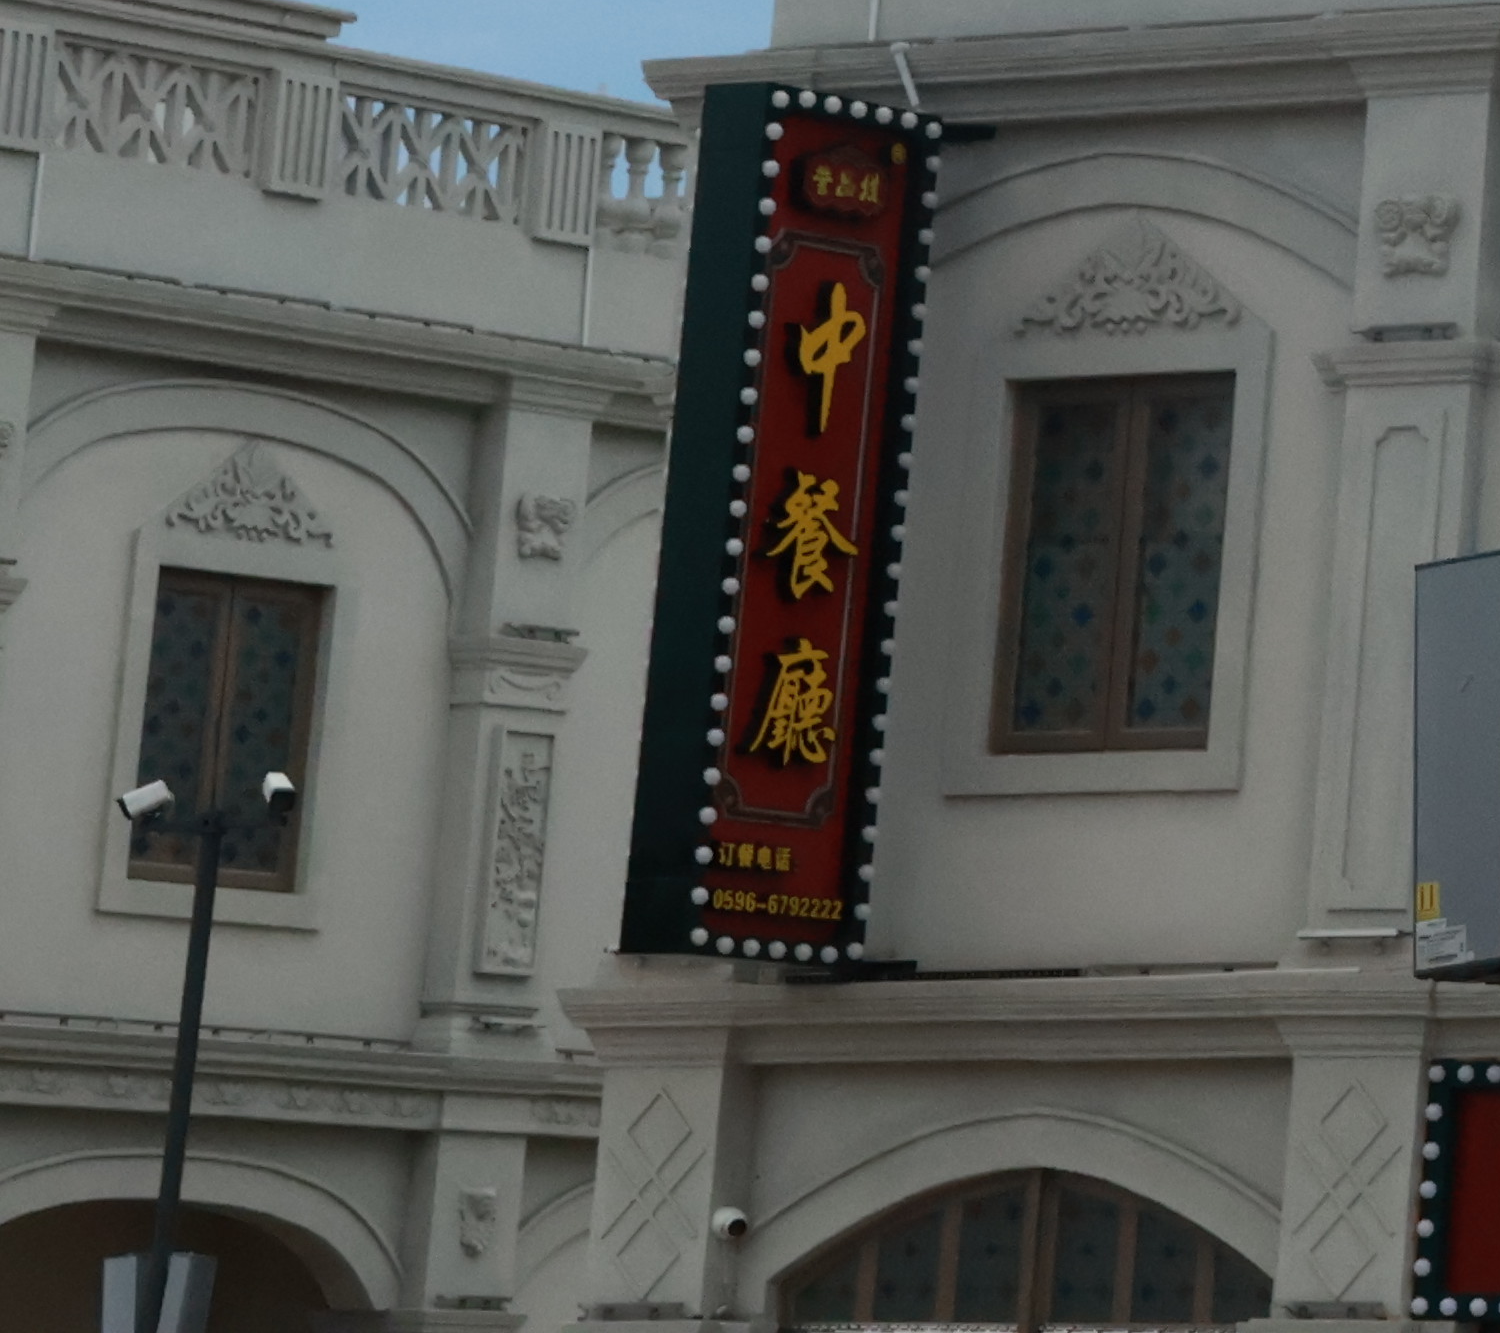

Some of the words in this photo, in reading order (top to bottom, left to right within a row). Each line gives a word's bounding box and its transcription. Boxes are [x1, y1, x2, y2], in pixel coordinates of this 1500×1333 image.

[750, 282, 866, 766] 中餐廳
[713, 888, 843, 920] 0596-6792222
